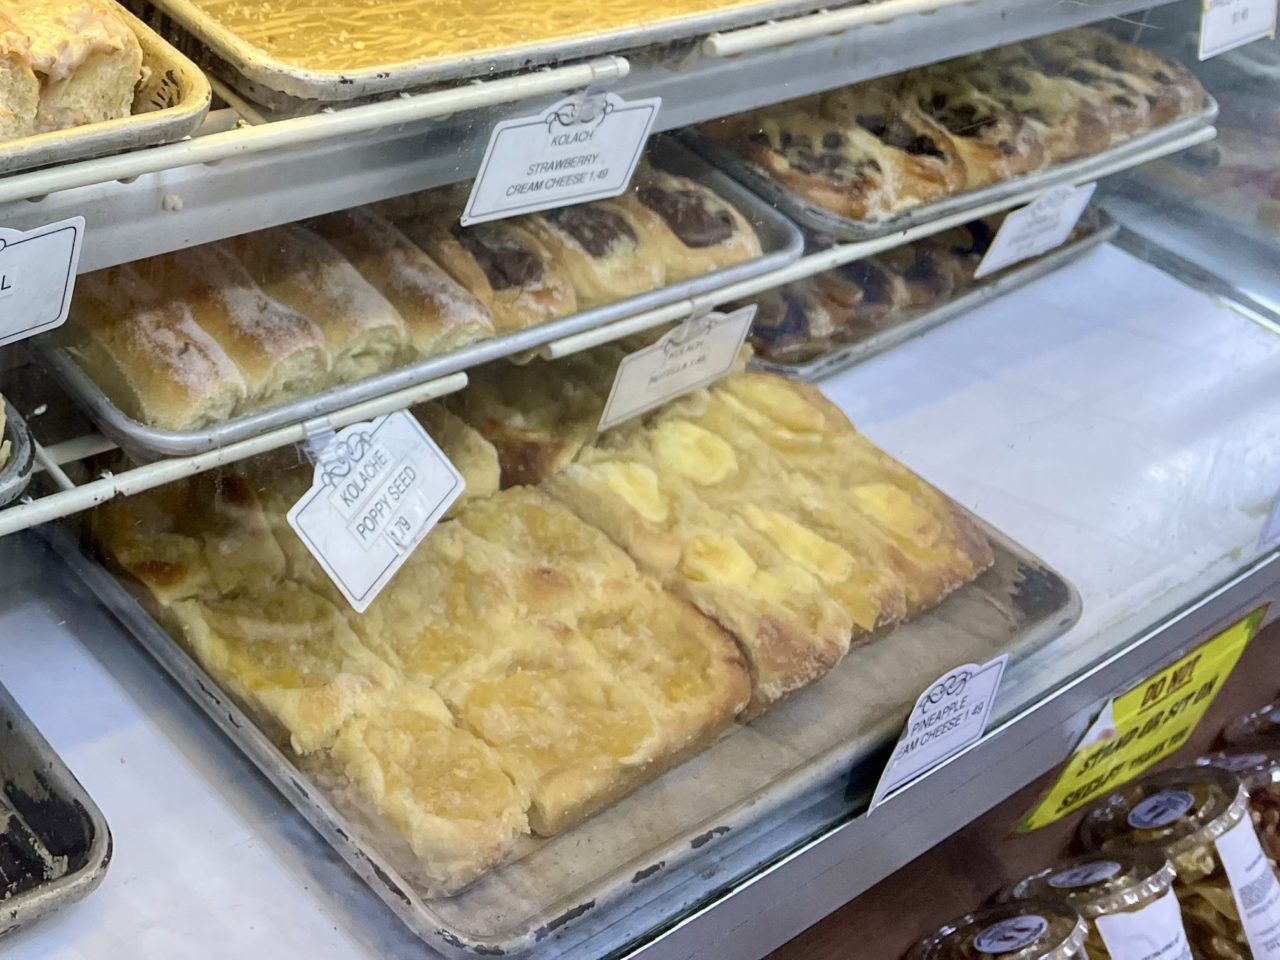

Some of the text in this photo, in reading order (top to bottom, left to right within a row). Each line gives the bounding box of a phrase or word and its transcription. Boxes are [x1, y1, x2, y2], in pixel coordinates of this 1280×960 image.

[551, 130, 594, 147] KOLACH
[505, 168, 609, 197] CREAM CHEESE 1.49
[526, 153, 600, 176] STRAWBERRY
[339, 449, 388, 508] KOLACHE
[356, 465, 416, 541] POPPY SEED
[911, 695, 969, 737] PINEAPPLE
[920, 713, 963, 747] CHEESE
[965, 701, 985, 722] 1.49
